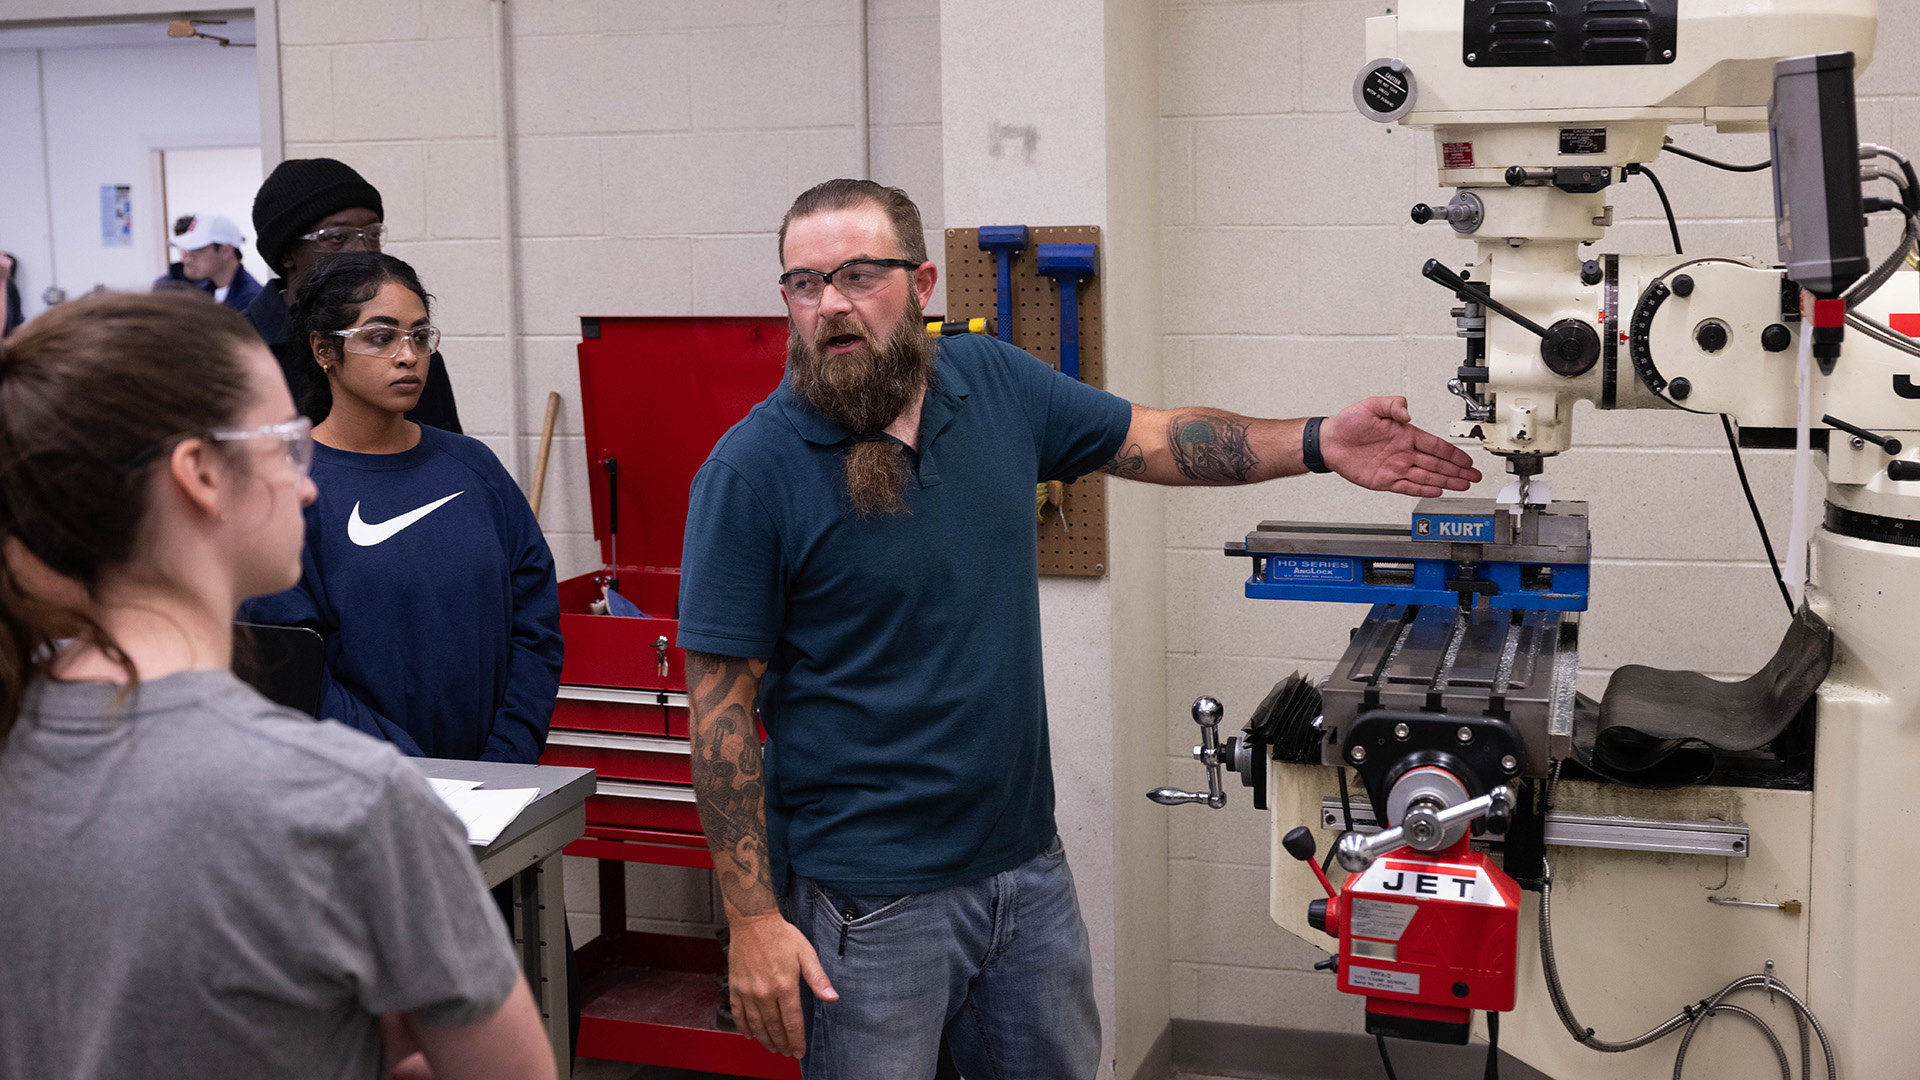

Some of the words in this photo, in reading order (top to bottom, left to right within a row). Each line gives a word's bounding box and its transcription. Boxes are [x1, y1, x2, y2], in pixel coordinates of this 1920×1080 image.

[1385, 72, 1402, 85] CAUTION
[1894, 522, 1904, 530] 40
[1301, 561, 1349, 569] SERIES
[1383, 872, 1475, 898] JET
